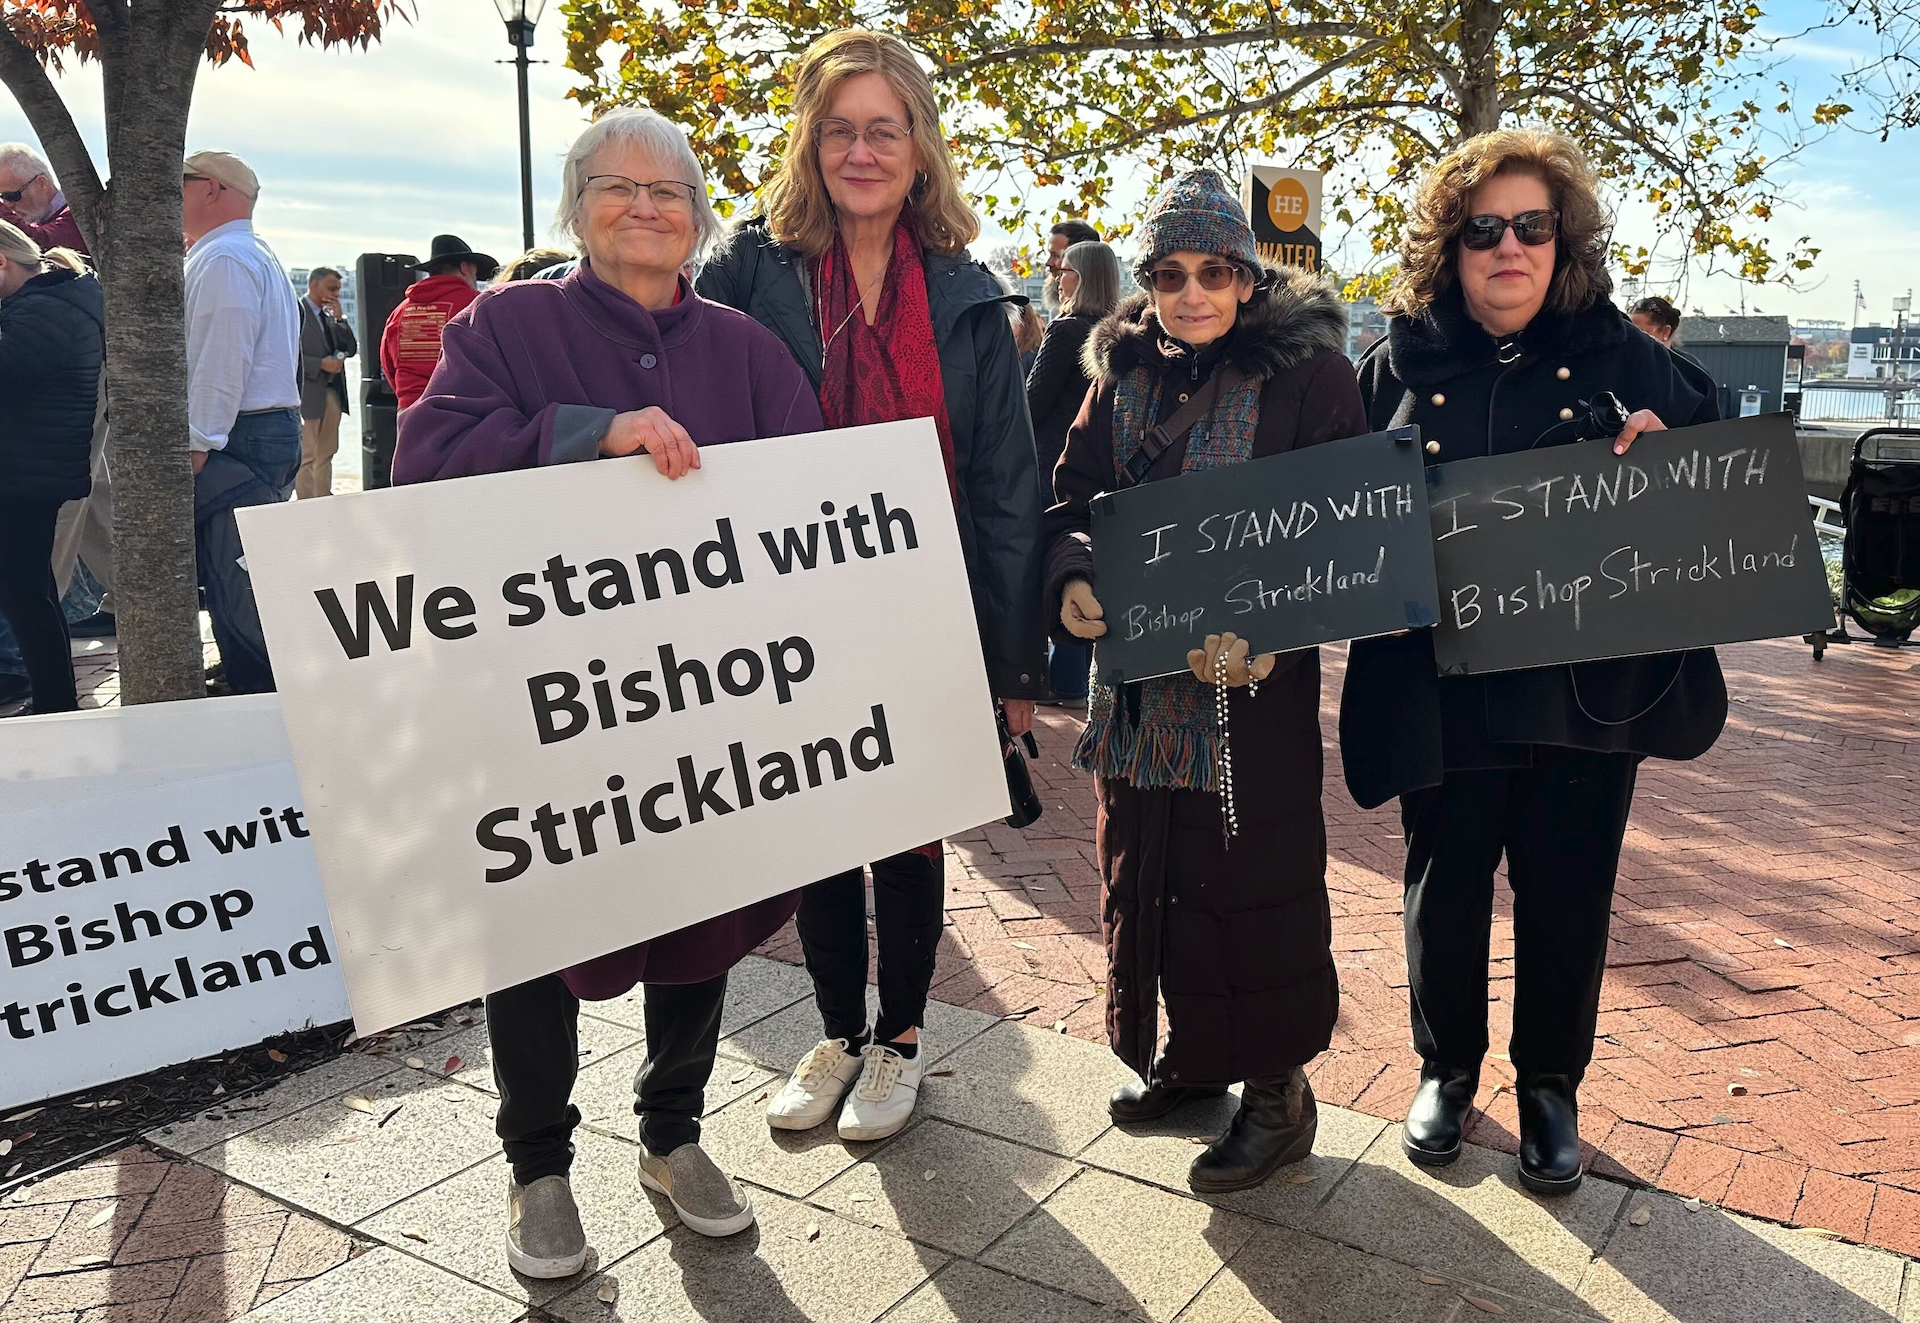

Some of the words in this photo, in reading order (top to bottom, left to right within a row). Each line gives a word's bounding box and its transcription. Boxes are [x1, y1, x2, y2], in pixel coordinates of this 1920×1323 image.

[1274, 194, 1303, 215] HE
[1141, 522, 1178, 565] I
[1196, 500, 1319, 554] STAND
[1430, 492, 1478, 541] I
[1491, 464, 1649, 520] STAND
[1667, 448, 1770, 491] WITH
[313, 573, 478, 660] We
[502, 517, 745, 627] stand
[757, 491, 919, 576] with
[1122, 604, 1205, 641] Bishop
[1224, 545, 1386, 615] Strickland
[1450, 569, 1593, 630] Bishop
[1599, 533, 1799, 600] Strickland
[526, 635, 815, 745] Bishop
[475, 703, 895, 884] Strickland
[0, 824, 191, 902] stand
[203, 806, 311, 855] wit
[3, 889, 254, 968] Bishop
[0, 925, 332, 1040] trickland
